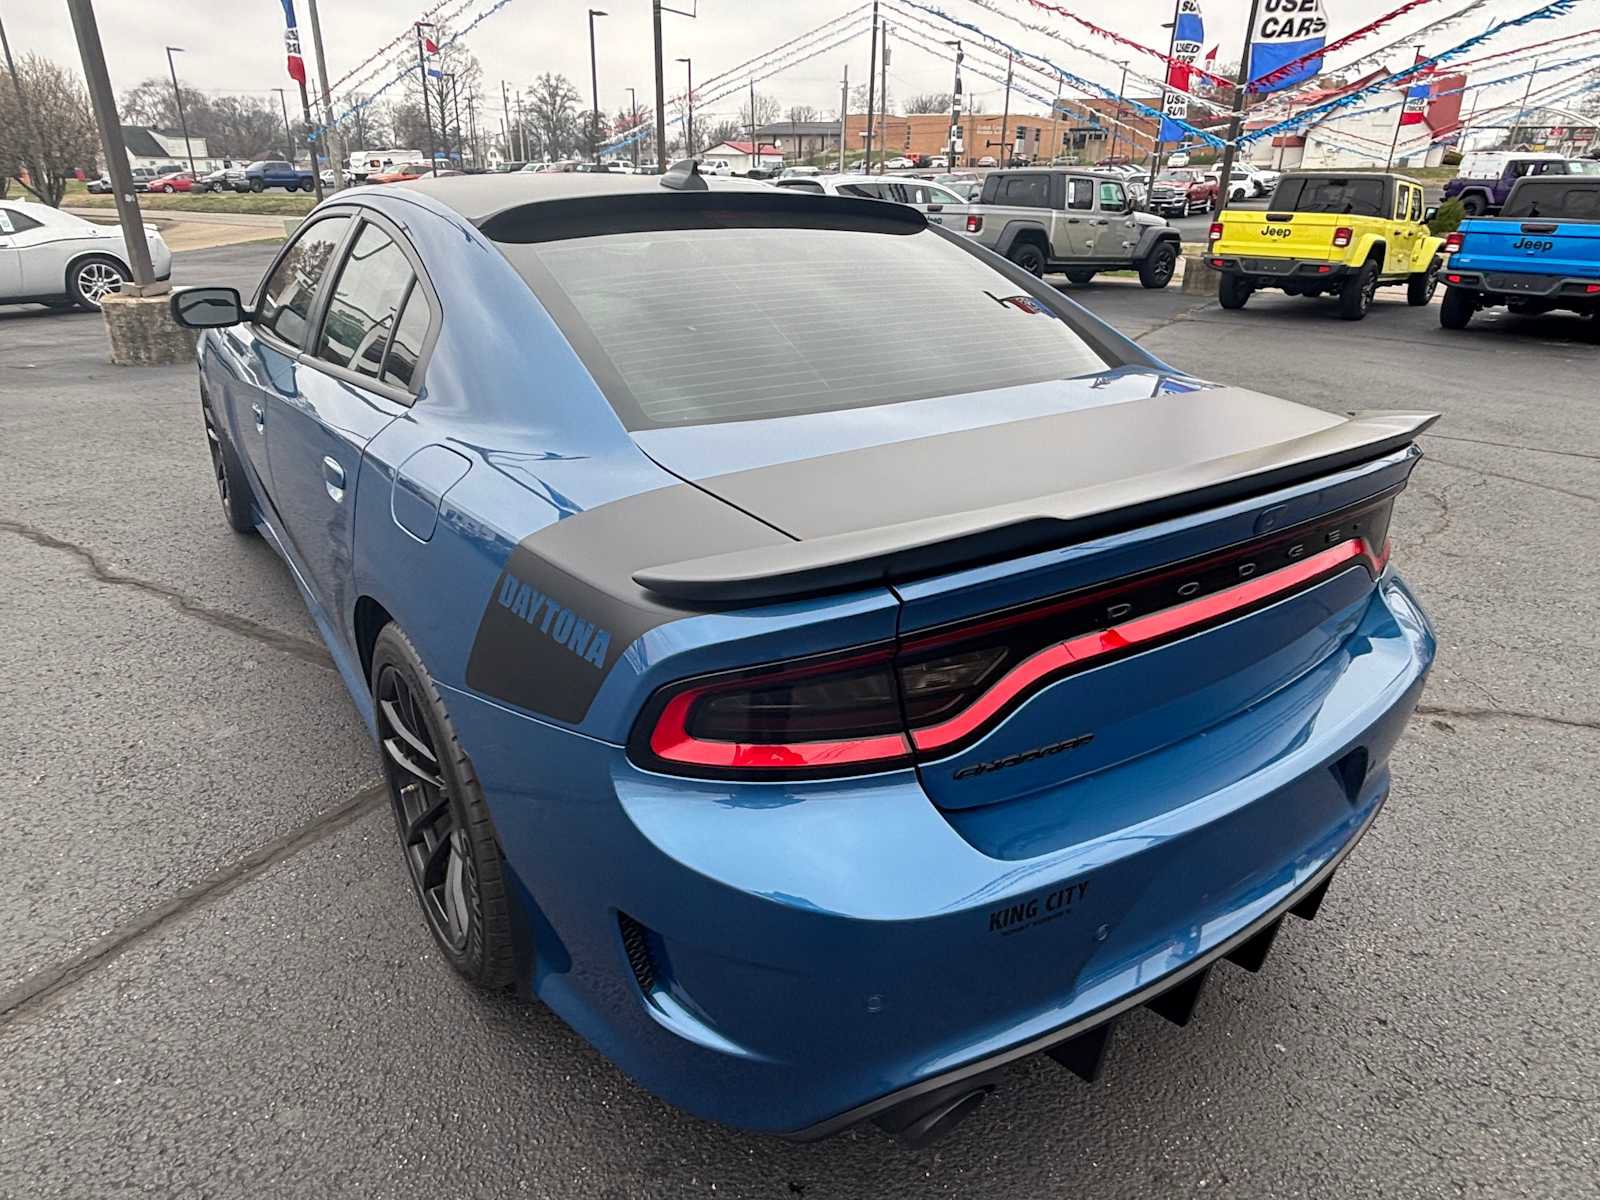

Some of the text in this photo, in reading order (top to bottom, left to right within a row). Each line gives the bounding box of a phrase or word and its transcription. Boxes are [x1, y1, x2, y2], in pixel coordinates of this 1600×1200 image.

[1265, 0, 1319, 13] USE
[1260, 16, 1327, 39] CARS
[1260, 225, 1292, 239] Jeep
[1513, 237, 1553, 253] Jeep
[1107, 529, 1341, 619] DODGE
[497, 575, 611, 670] DAYTONA
[989, 898, 1038, 932] KING
[1045, 880, 1089, 912] CITY
